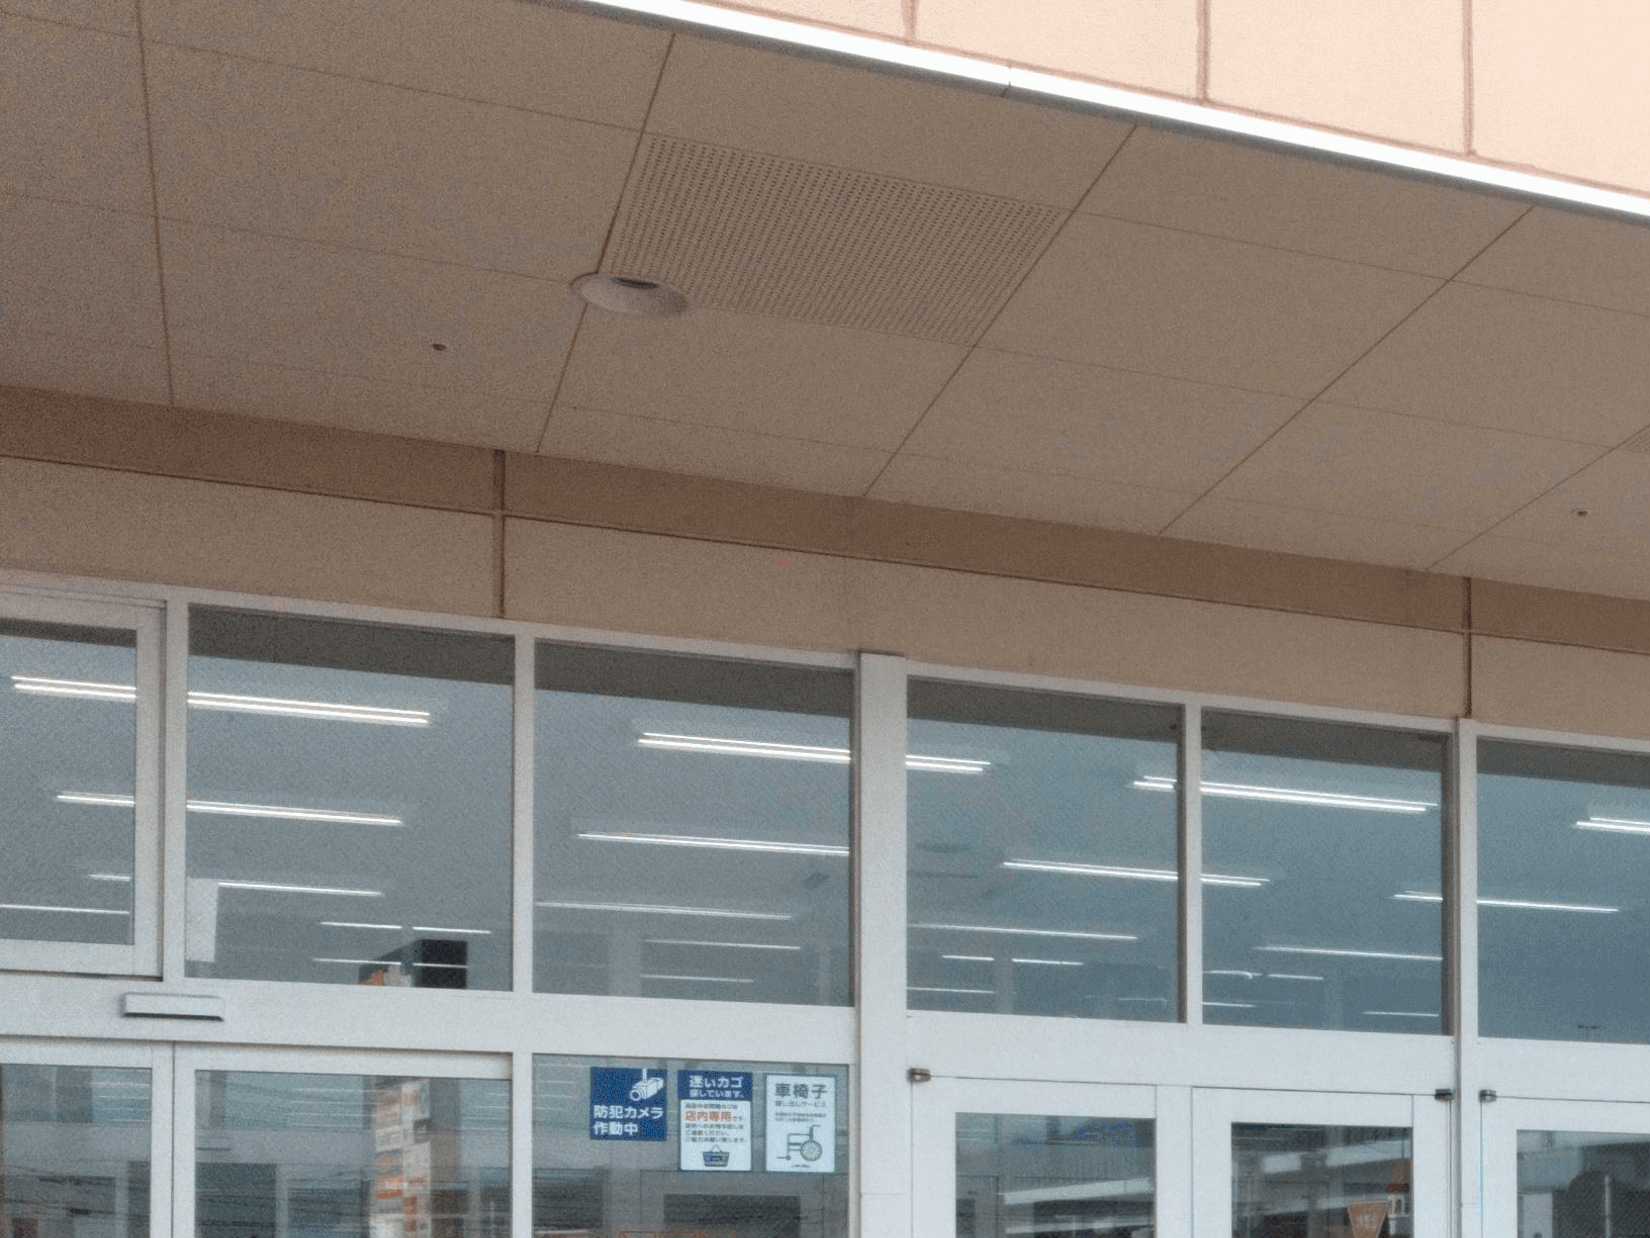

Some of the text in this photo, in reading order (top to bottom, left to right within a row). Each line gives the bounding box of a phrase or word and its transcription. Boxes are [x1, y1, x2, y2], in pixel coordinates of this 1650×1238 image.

[775, 1083, 828, 1100] 車椅子
[593, 1104, 664, 1119] 防犯カメラ
[593, 1121, 639, 1136] 作動中
